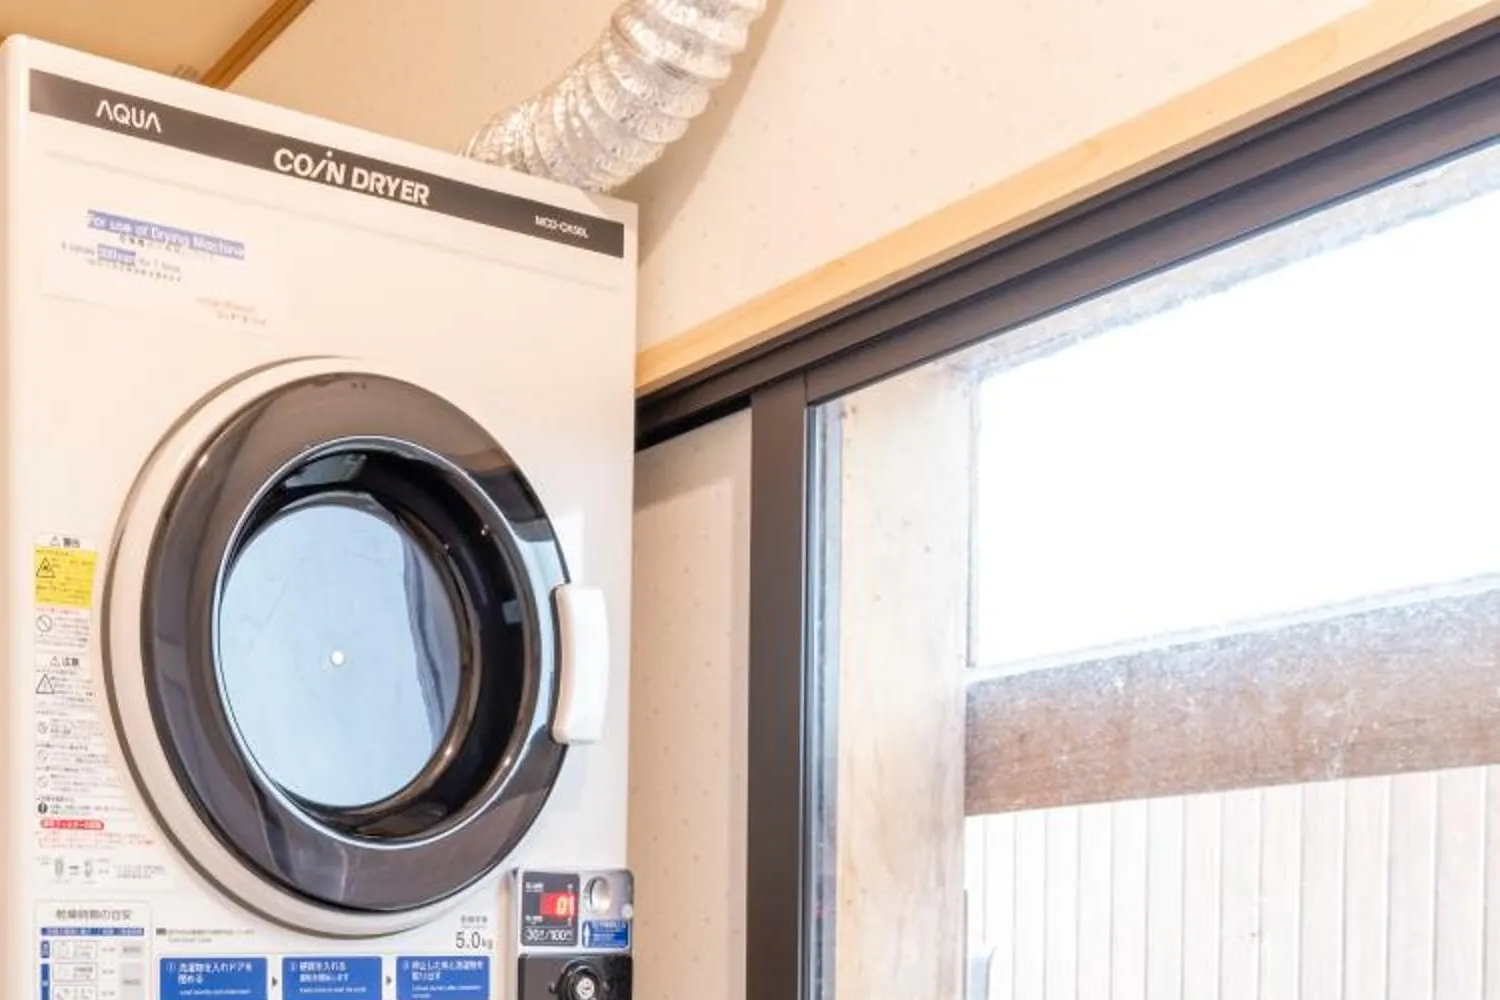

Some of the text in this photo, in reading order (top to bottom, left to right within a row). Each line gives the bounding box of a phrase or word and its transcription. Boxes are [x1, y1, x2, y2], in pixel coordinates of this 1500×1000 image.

[96, 99, 162, 133] AQUA
[352, 167, 431, 207] DRYER
[56, 908, 133, 922] 乾燥時間の目安
